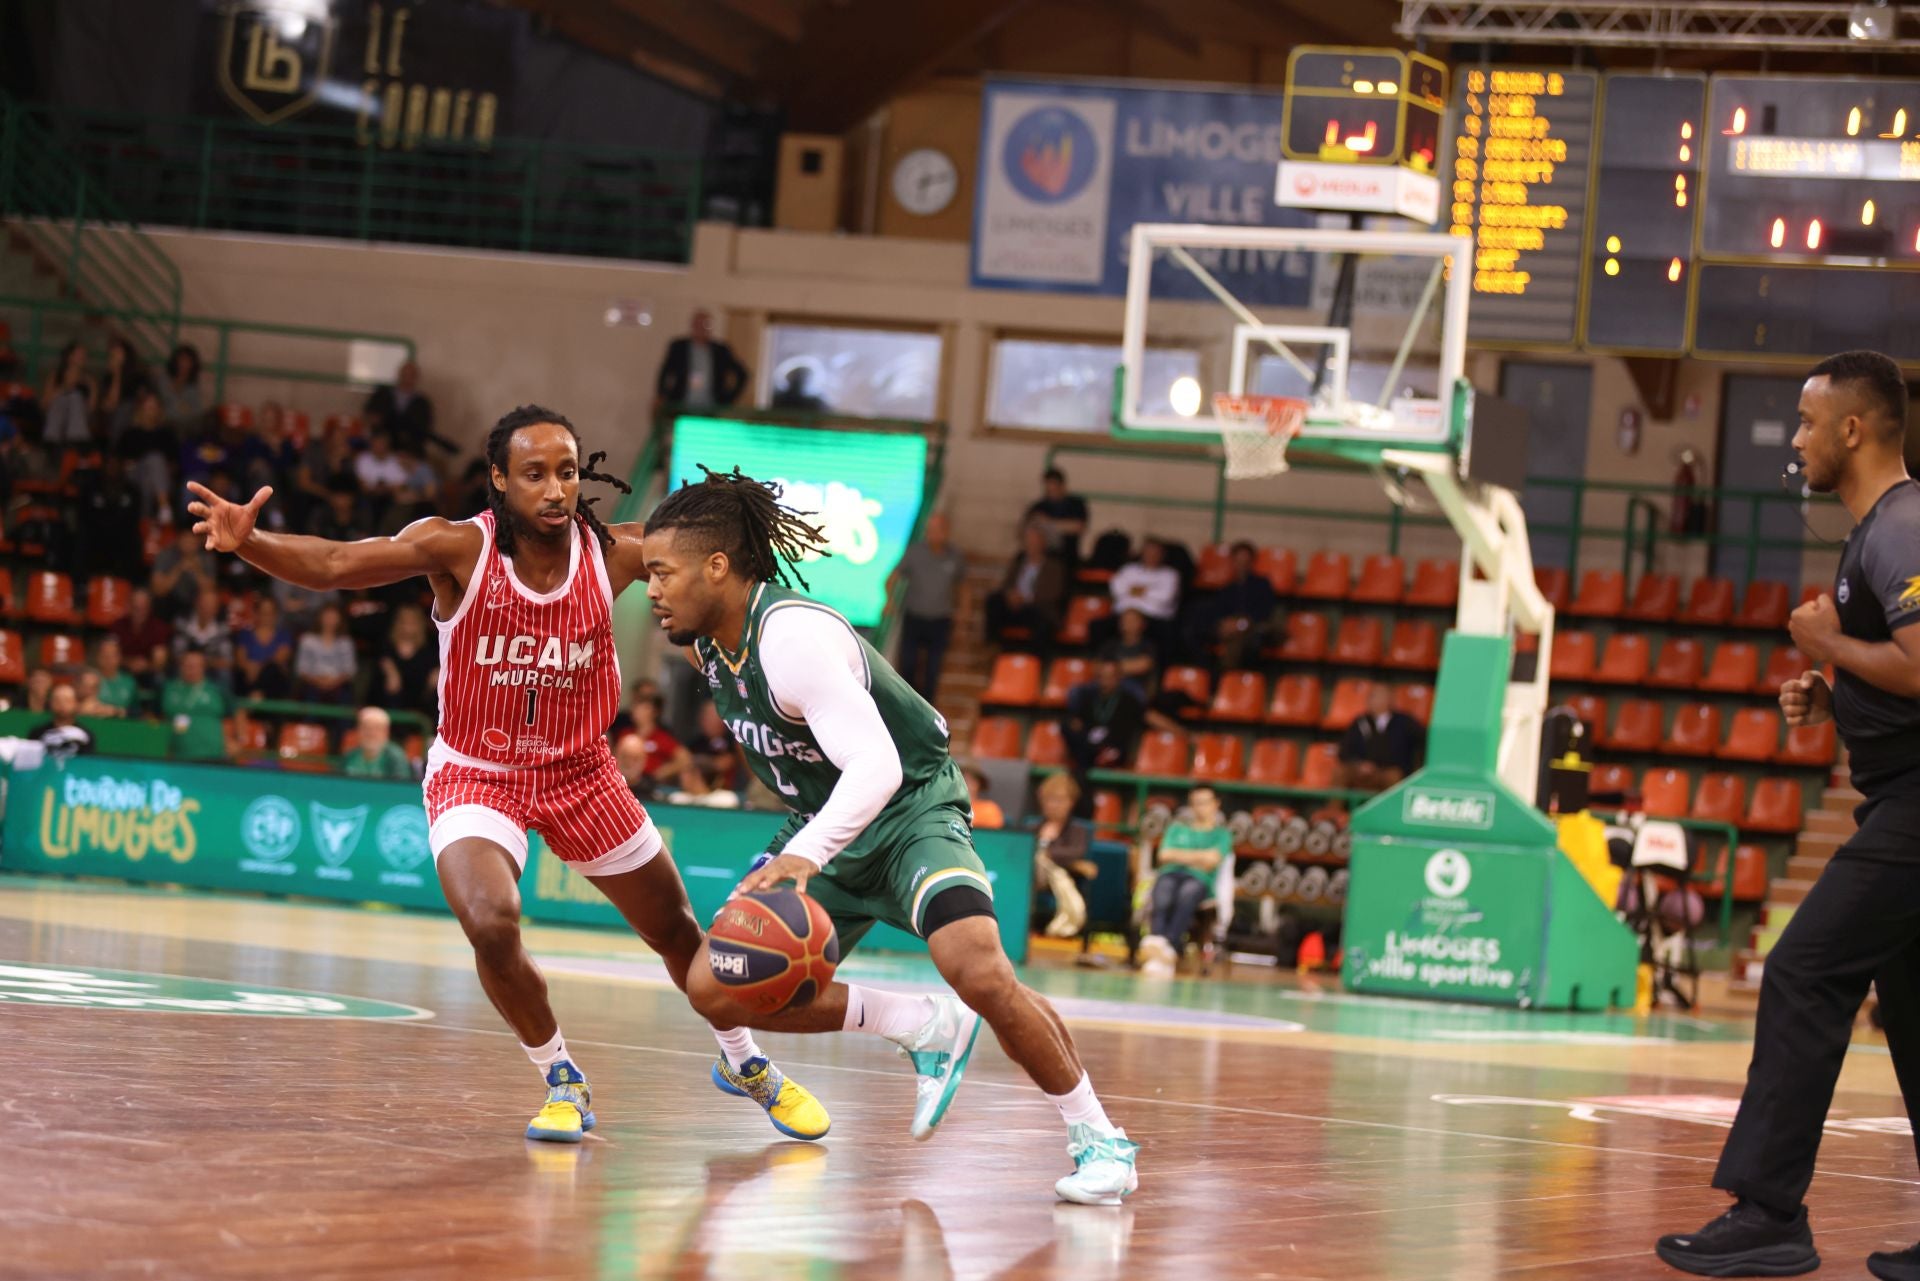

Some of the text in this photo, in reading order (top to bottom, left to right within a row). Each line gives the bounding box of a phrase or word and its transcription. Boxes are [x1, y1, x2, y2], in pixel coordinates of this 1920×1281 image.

[474, 634, 595, 672] UCAM
[490, 669, 575, 691] MURCIA
[525, 687, 539, 727] 1
[529, 746, 563, 756] MURCIA
